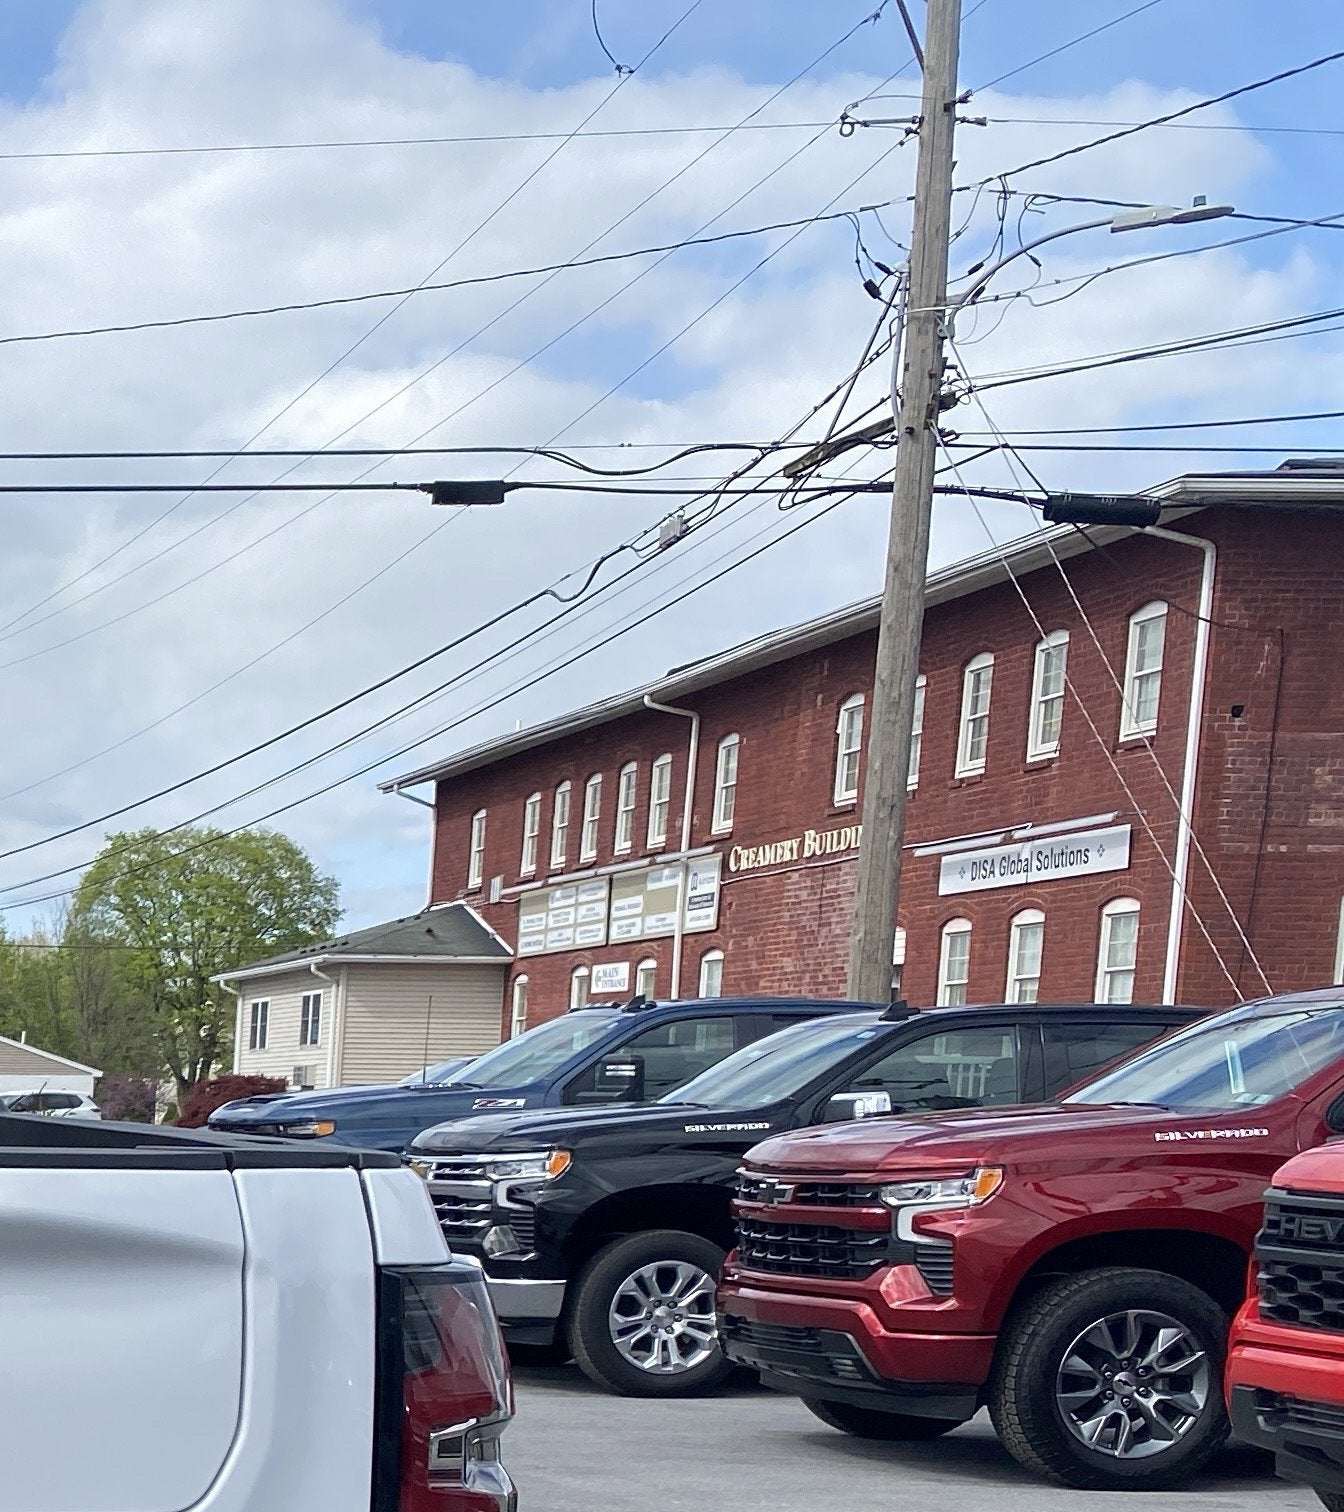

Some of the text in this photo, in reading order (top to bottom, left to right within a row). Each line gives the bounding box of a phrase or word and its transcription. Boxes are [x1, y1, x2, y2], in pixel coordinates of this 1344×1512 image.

[729, 838, 802, 873] CREAMERY
[970, 844, 1090, 882] DISA Global Solutions
[602, 966, 619, 978] MAIN
[472, 1098, 527, 1110] Z71
[684, 1121, 770, 1133] SILVERADO
[1154, 1128, 1269, 1142] SILVERADO
